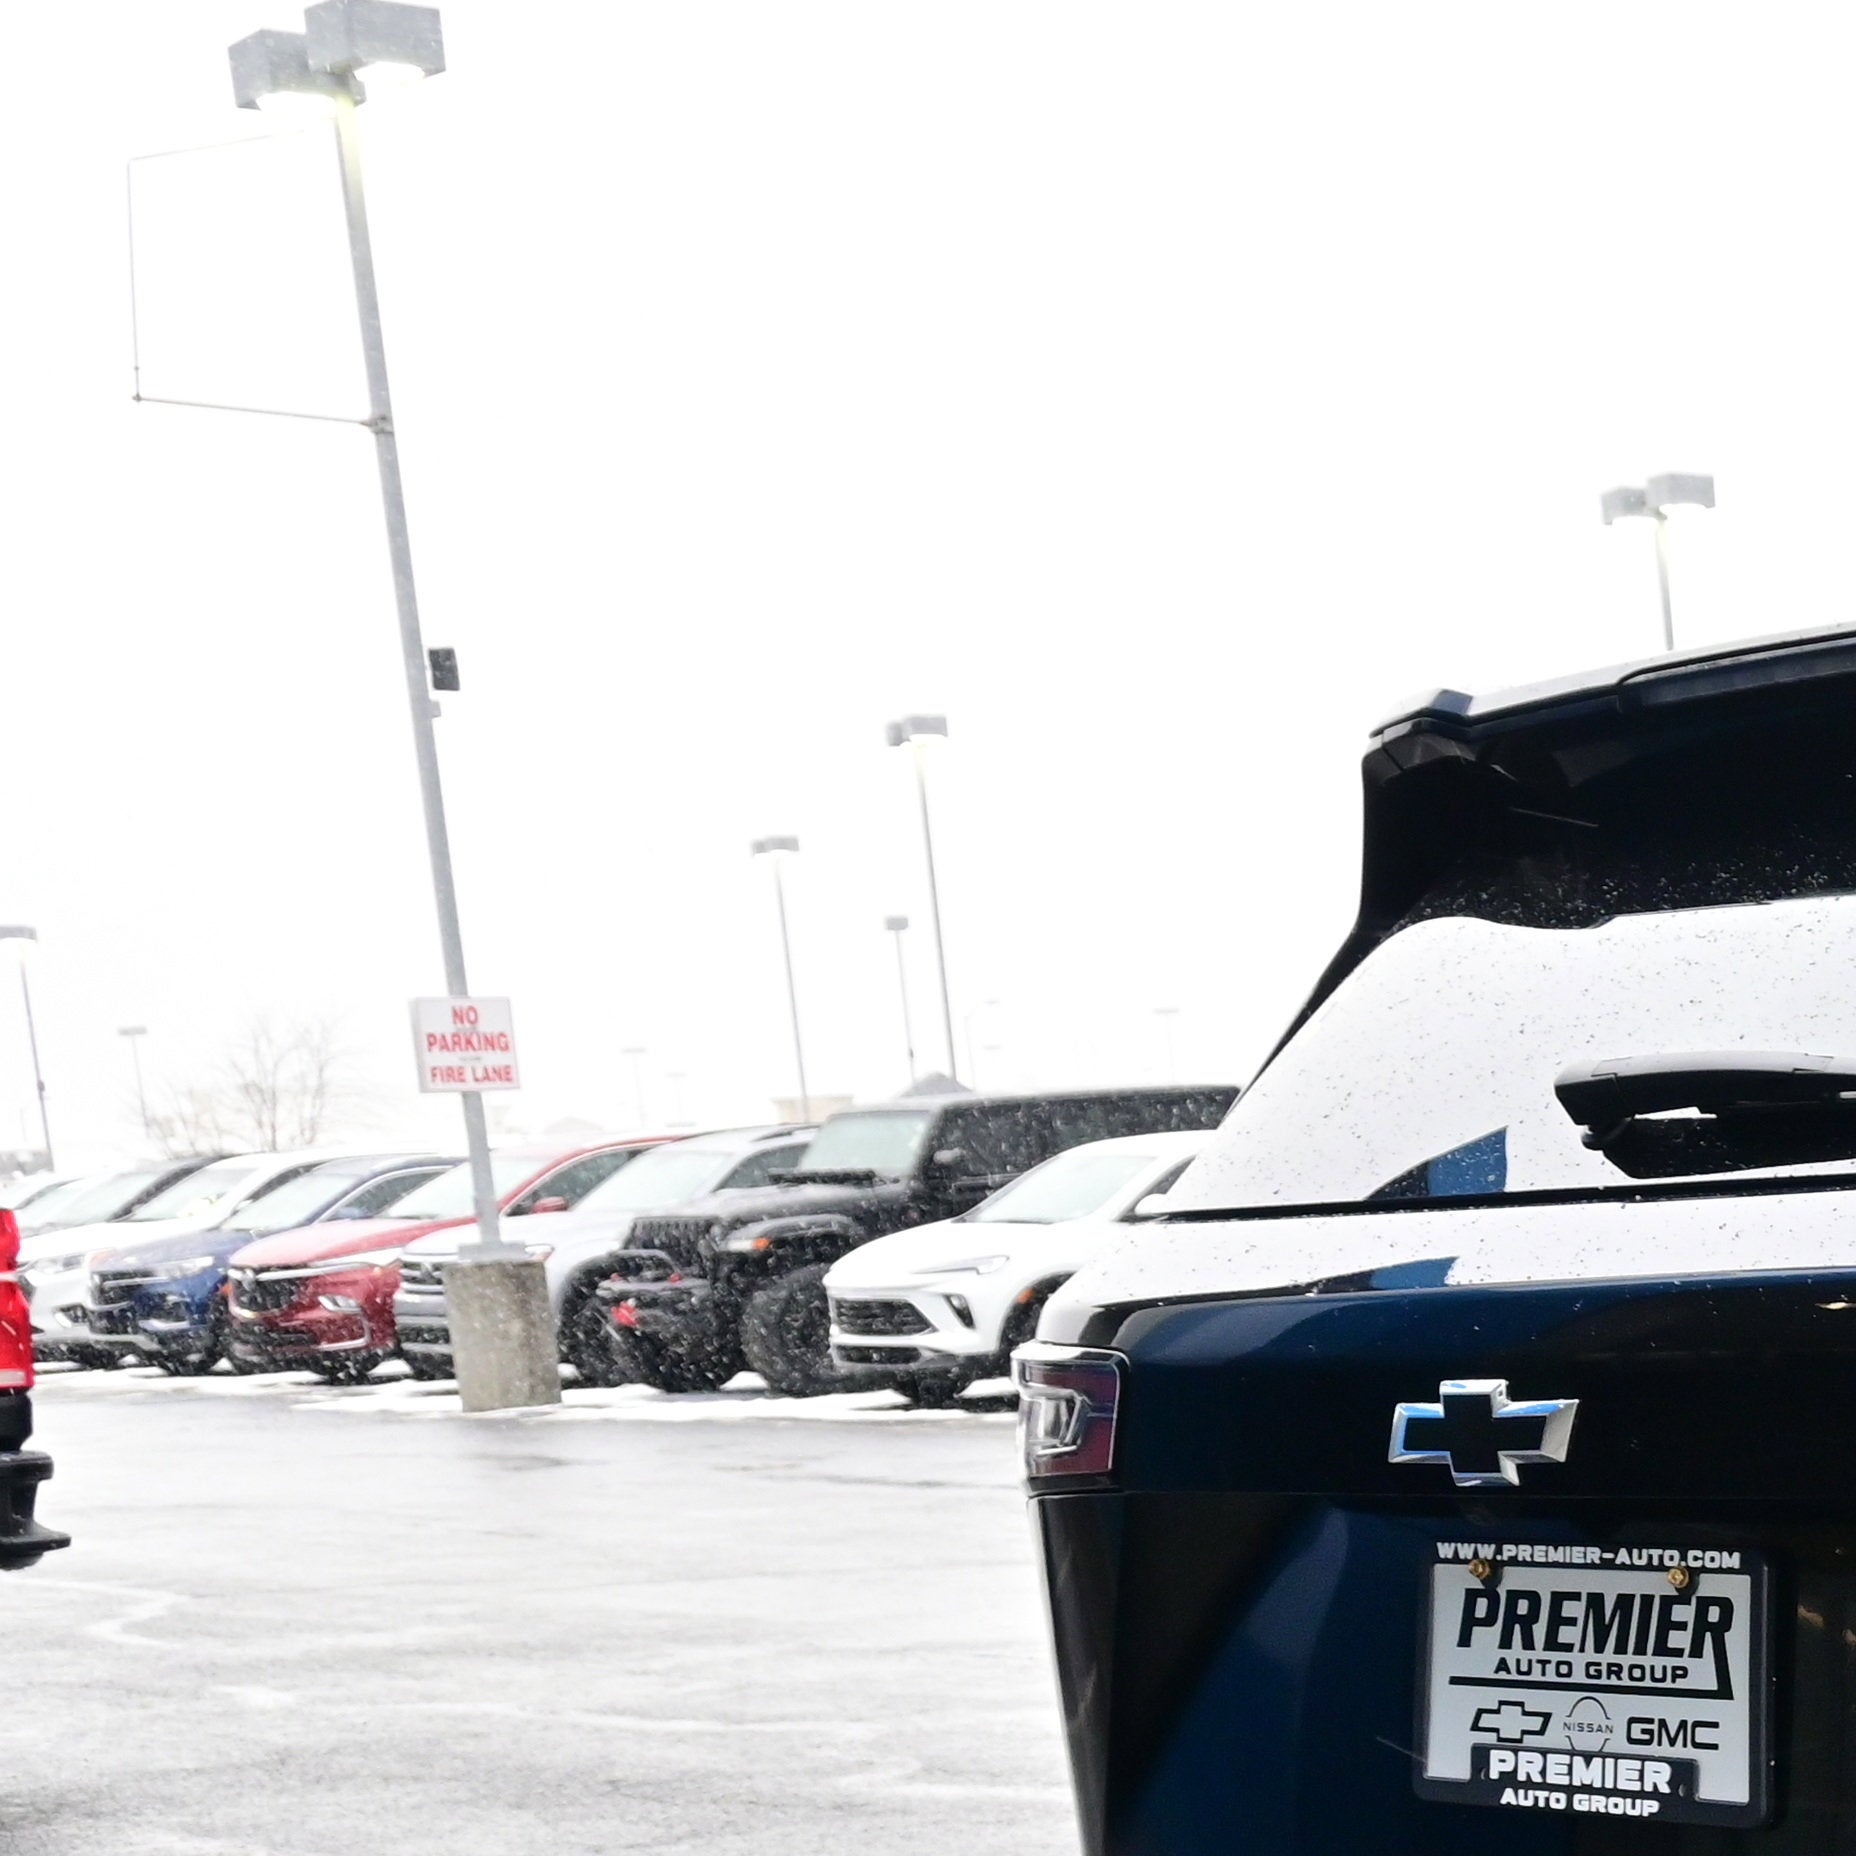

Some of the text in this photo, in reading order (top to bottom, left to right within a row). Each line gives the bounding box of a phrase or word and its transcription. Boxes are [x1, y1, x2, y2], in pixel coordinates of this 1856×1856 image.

[451, 1005, 479, 1025] NO
[426, 1032, 510, 1052] PARKING
[430, 1065, 514, 1083] FIRE LANE
[1436, 1541, 1741, 1569] WWW.PREMIER-AUTO.COM
[1456, 1587, 1735, 1661] PREMIER
[1493, 1656, 1689, 1684] AUTO GROUP
[1562, 1721, 1614, 1735] NISSAN
[1625, 1716, 1720, 1750] GMC
[1488, 1748, 1672, 1794] PREMIER
[1500, 1787, 1660, 1817] AUTO GROUP
